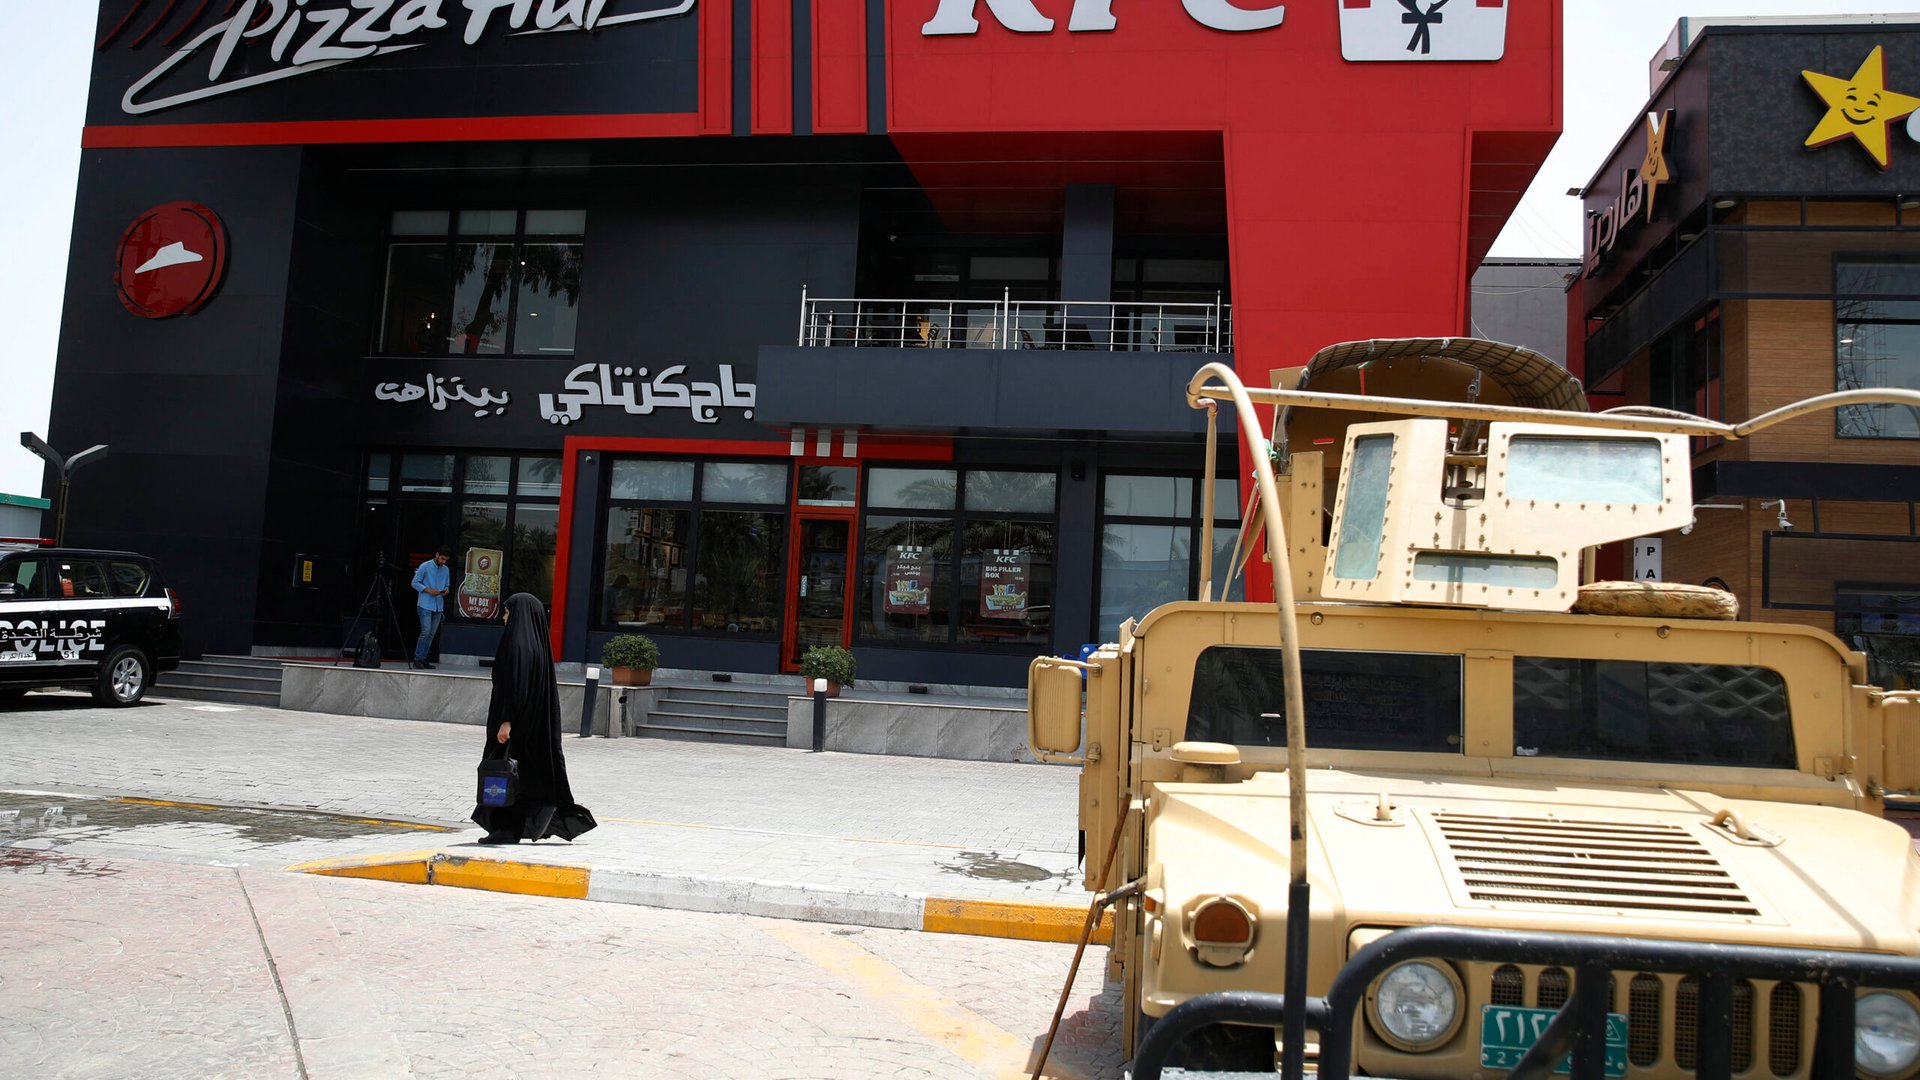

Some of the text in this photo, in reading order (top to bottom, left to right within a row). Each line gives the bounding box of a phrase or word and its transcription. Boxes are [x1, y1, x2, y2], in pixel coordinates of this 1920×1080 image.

[538, 363, 691, 426] كنتاكي
[899, 552, 919, 560] KFC
[996, 555, 1016, 564] KFC
[63, 650, 75, 659] 51
